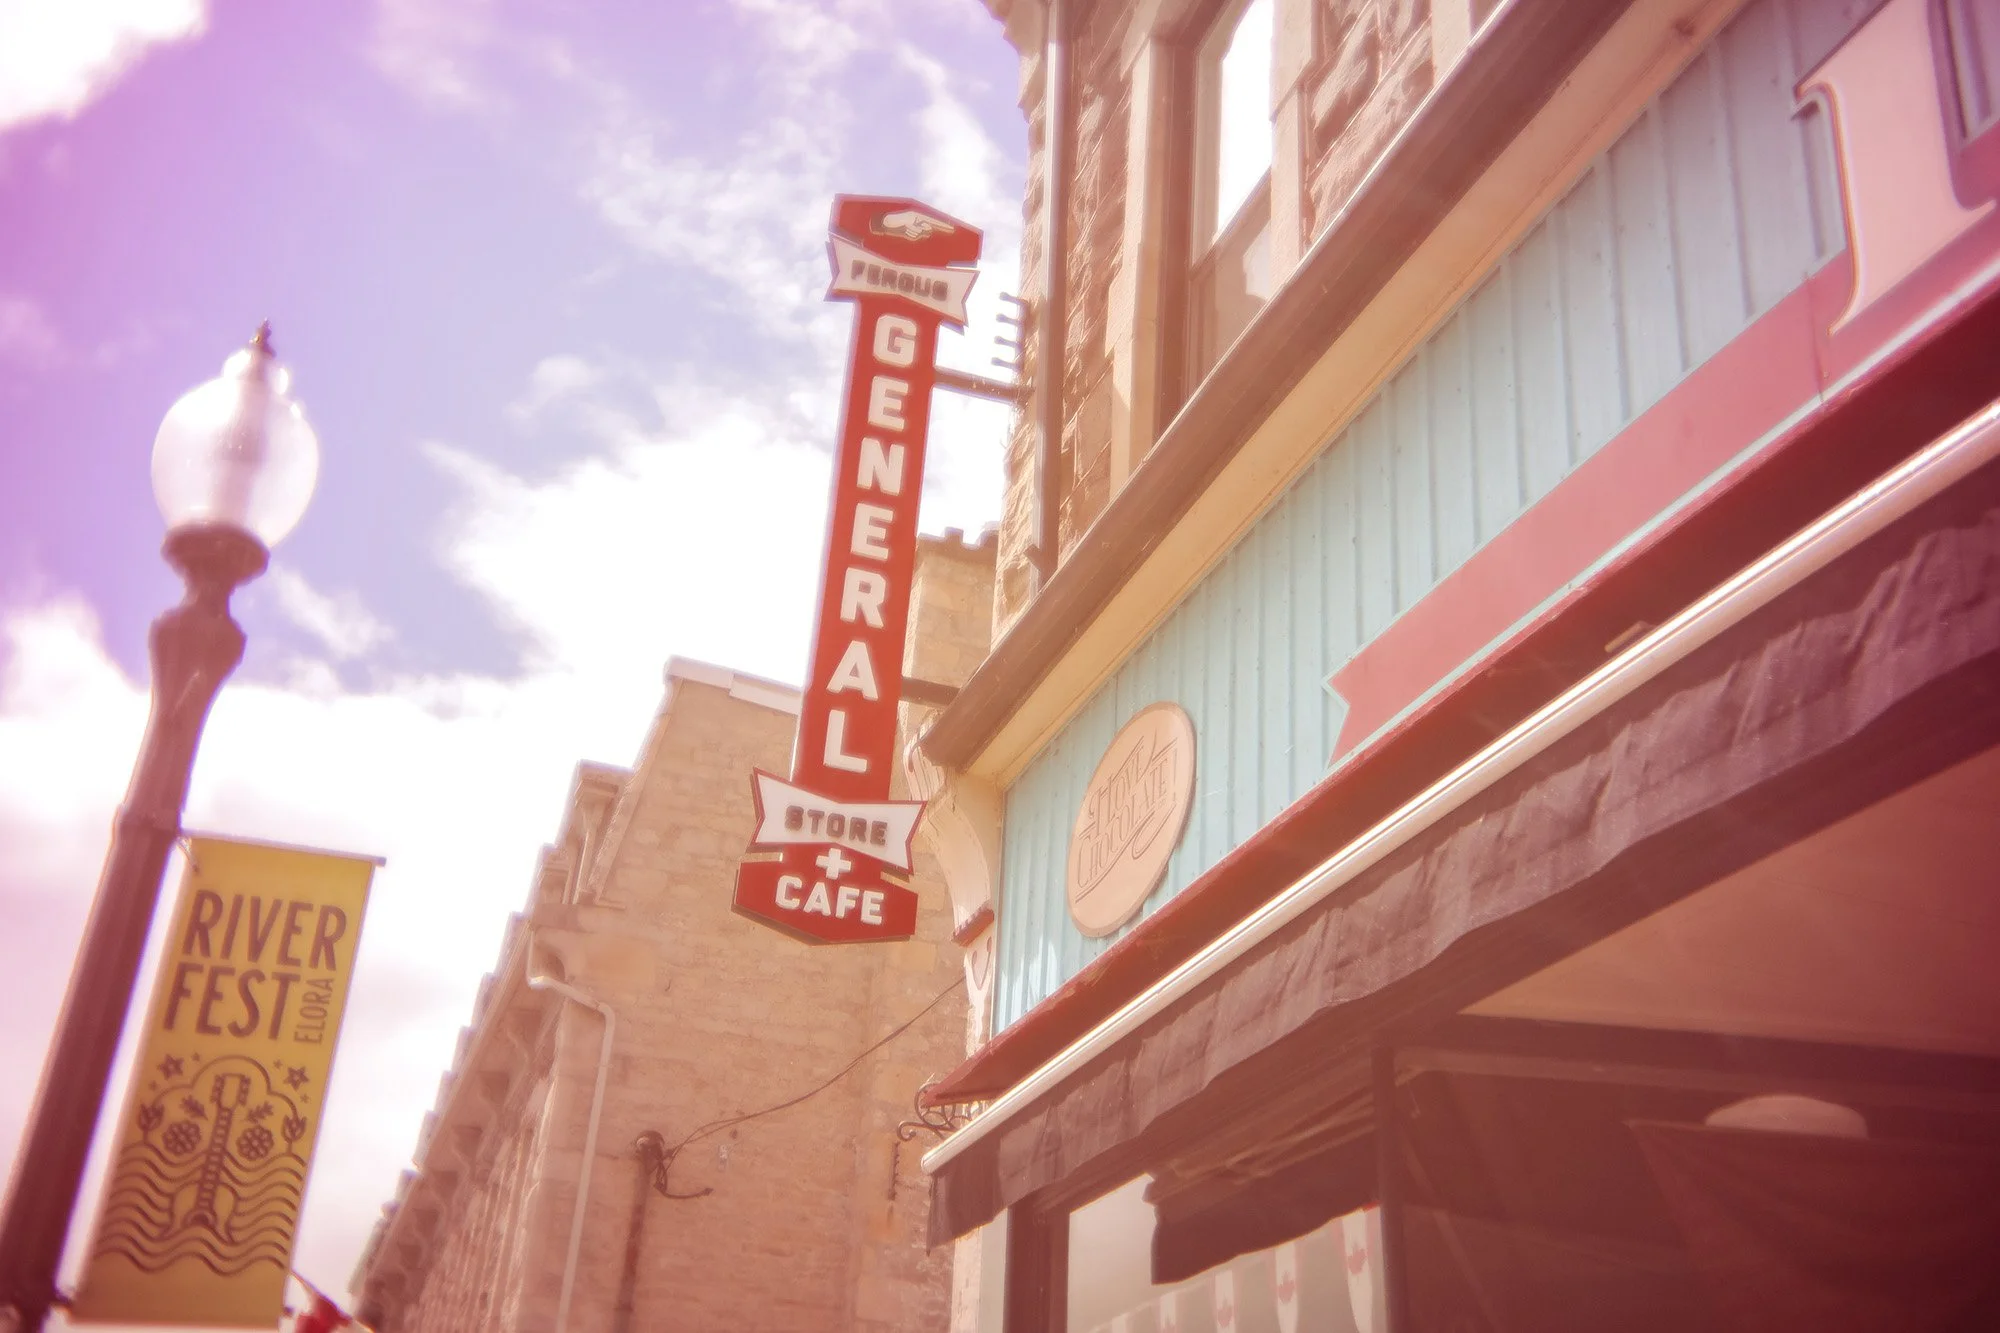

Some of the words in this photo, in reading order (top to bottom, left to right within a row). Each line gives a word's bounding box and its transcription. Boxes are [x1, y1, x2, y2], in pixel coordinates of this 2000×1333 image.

[850, 259, 949, 302] FERGUS
[823, 314, 918, 773] GENERAL
[785, 805, 888, 846] STORE
[182, 890, 347, 971] RIVER
[775, 875, 885, 926] CAFE
[162, 961, 301, 1041] FEST
[293, 976, 335, 1045] ELORA
